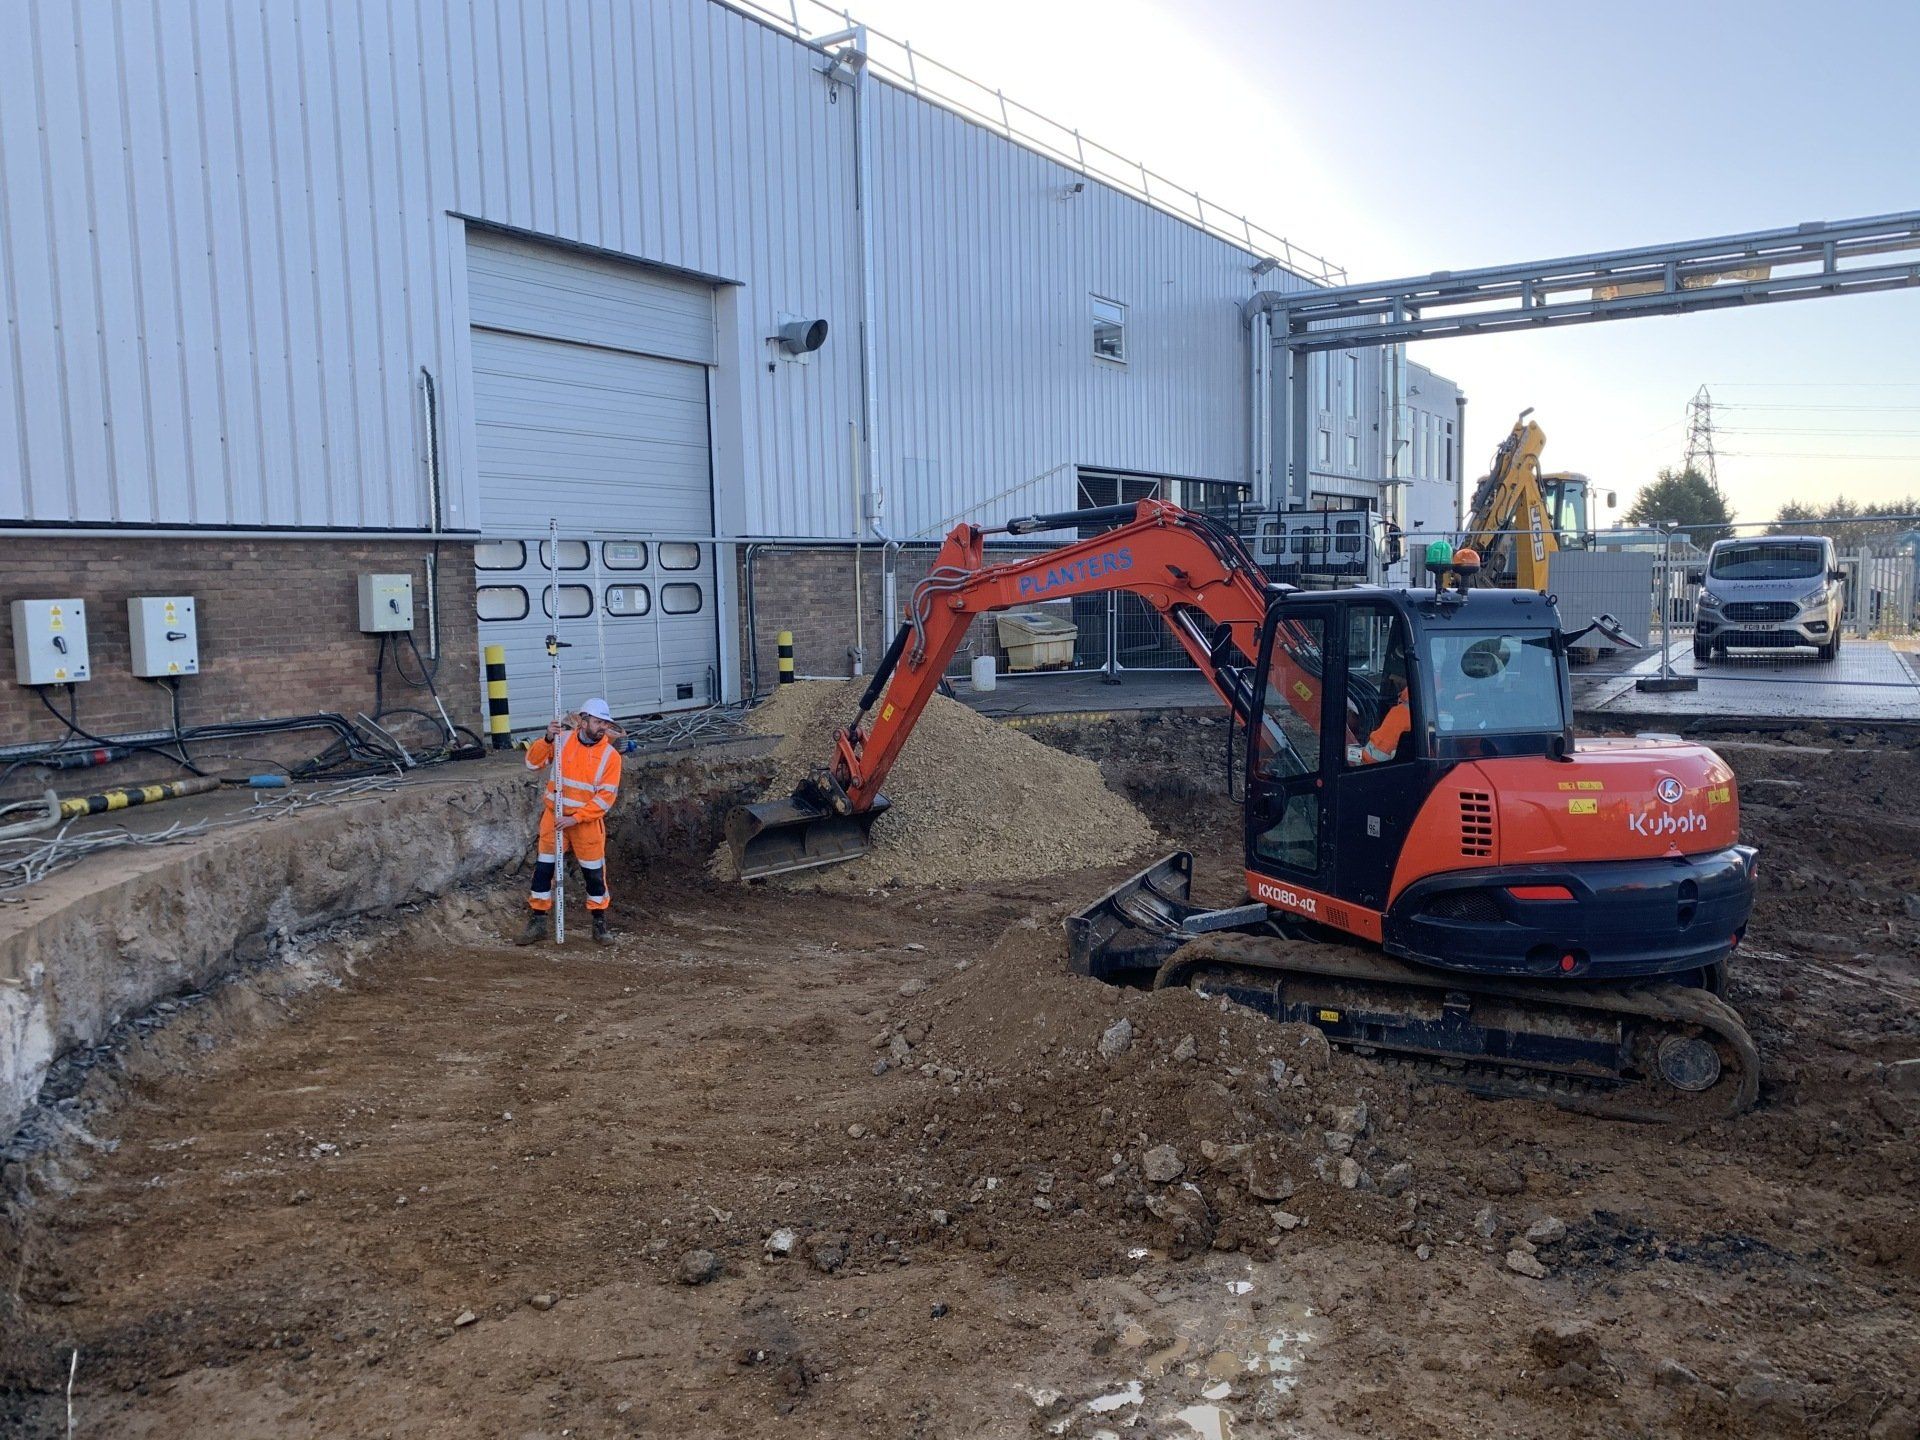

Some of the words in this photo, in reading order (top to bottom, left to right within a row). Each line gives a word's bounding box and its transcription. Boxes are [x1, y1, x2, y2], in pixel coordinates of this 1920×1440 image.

[1530, 506, 1545, 561] JCB
[1019, 547, 1134, 596] PLANTERS
[1629, 809, 1707, 836] Kubota
